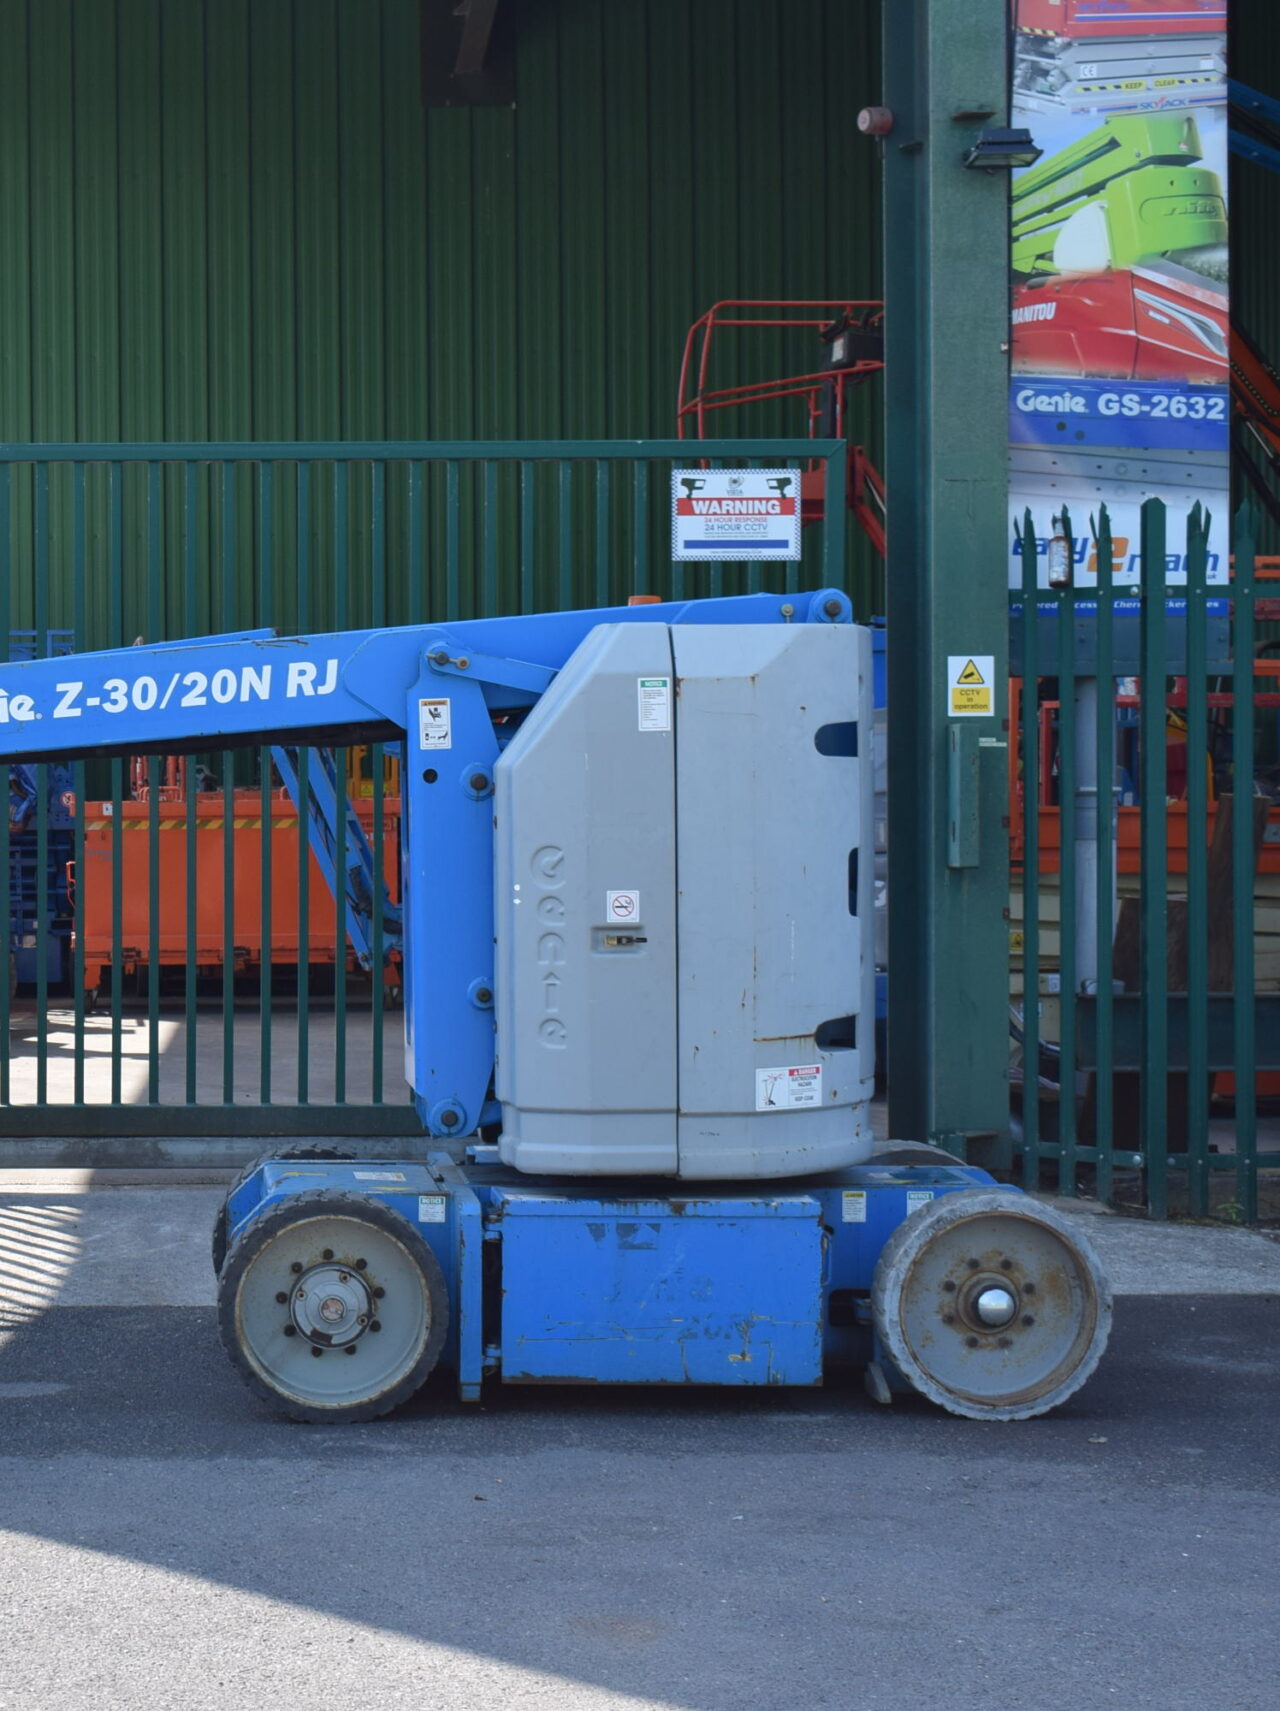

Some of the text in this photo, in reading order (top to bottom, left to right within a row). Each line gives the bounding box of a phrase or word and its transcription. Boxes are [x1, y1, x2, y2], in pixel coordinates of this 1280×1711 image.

[1016, 389, 1225, 420] Genie GS-2632
[692, 500, 781, 514] WARNING
[53, 665, 273, 718] Z-30/20N
[286, 659, 339, 698] RJ
